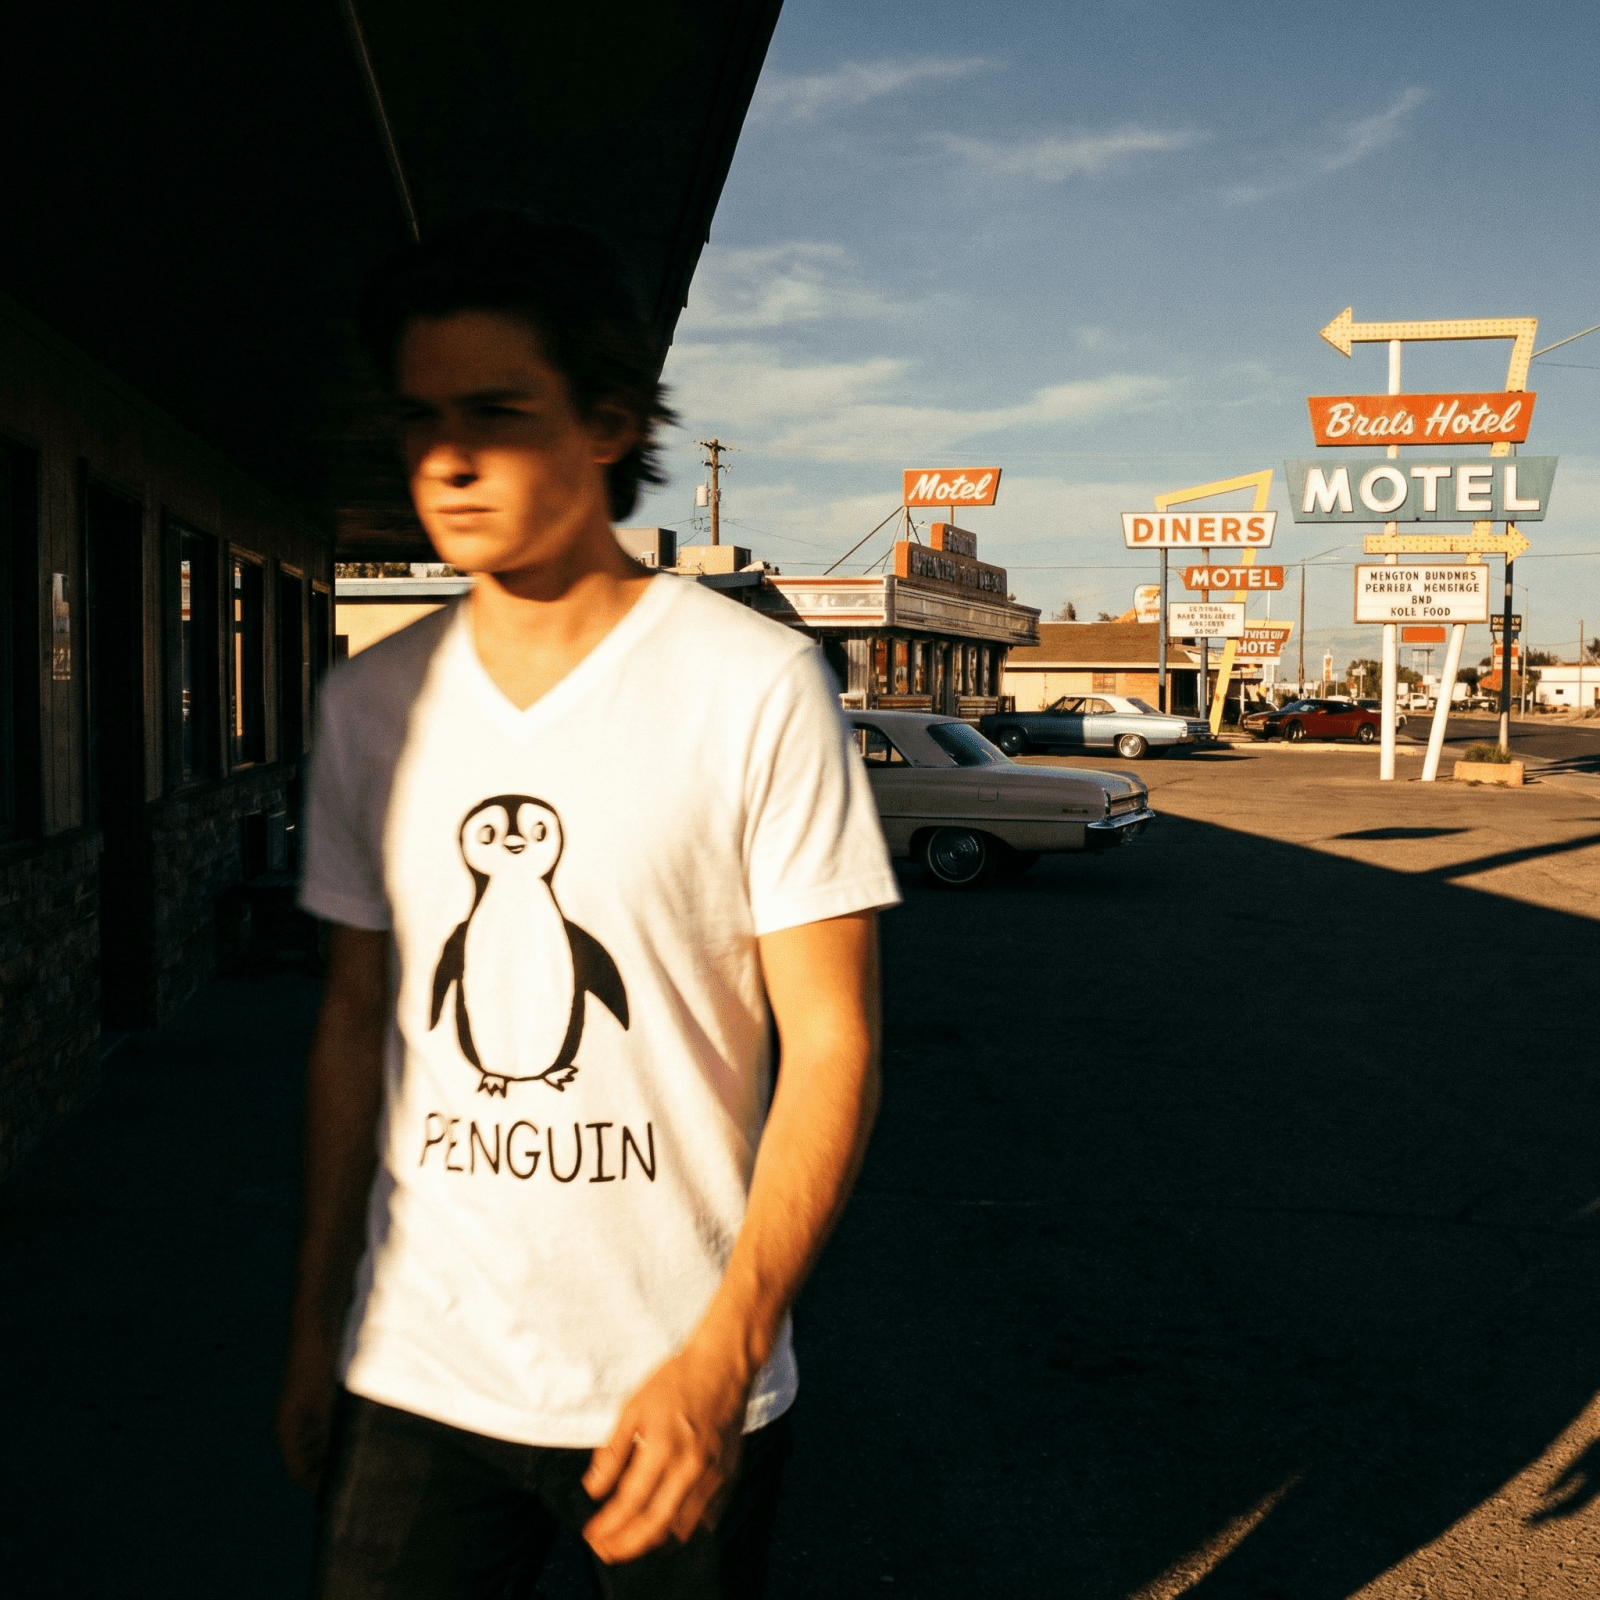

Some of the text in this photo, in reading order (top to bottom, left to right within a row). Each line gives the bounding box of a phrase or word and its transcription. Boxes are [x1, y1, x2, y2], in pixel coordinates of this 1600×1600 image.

[1425, 400, 1522, 437] Hotel
[908, 473, 993, 501] Motel
[1302, 465, 1541, 513] MOTEL
[1132, 517, 1265, 543] DINERS
[1190, 568, 1278, 588] MOTEL
[1423, 607, 1451, 616] FOOD
[418, 1112, 656, 1183] PENGUIN
